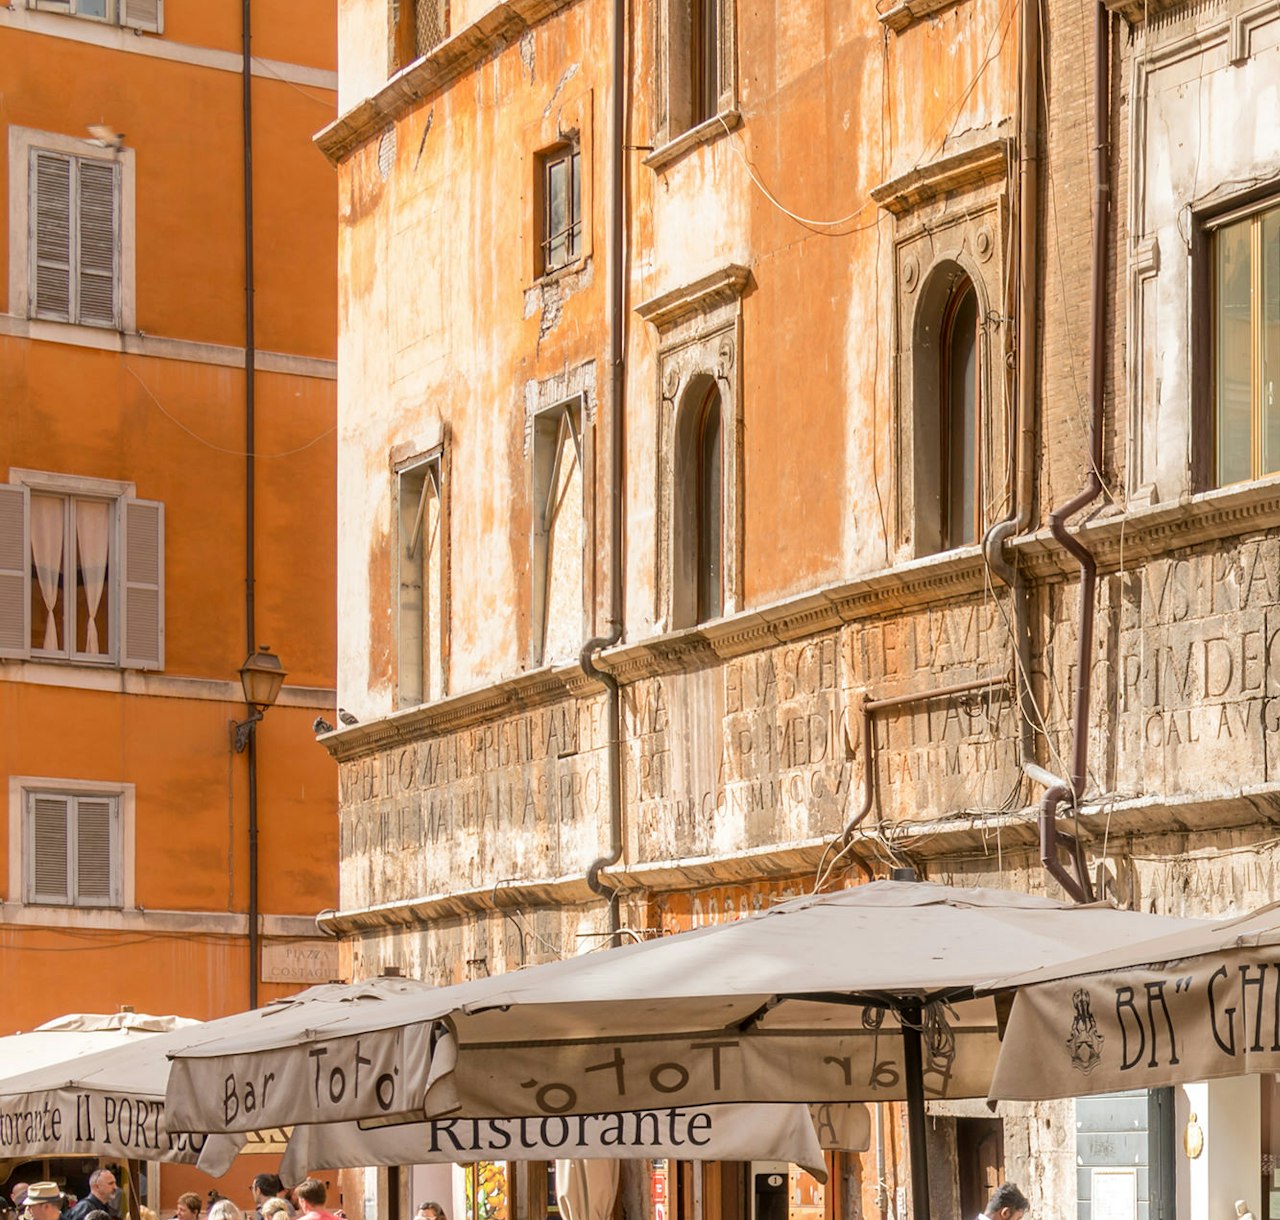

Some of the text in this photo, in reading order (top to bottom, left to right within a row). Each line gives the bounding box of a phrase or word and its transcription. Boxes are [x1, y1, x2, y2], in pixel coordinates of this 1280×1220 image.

[286, 948, 329, 961] PIAZZA
[75, 1094, 96, 1143] IL
[223, 1071, 276, 1127] Bar
